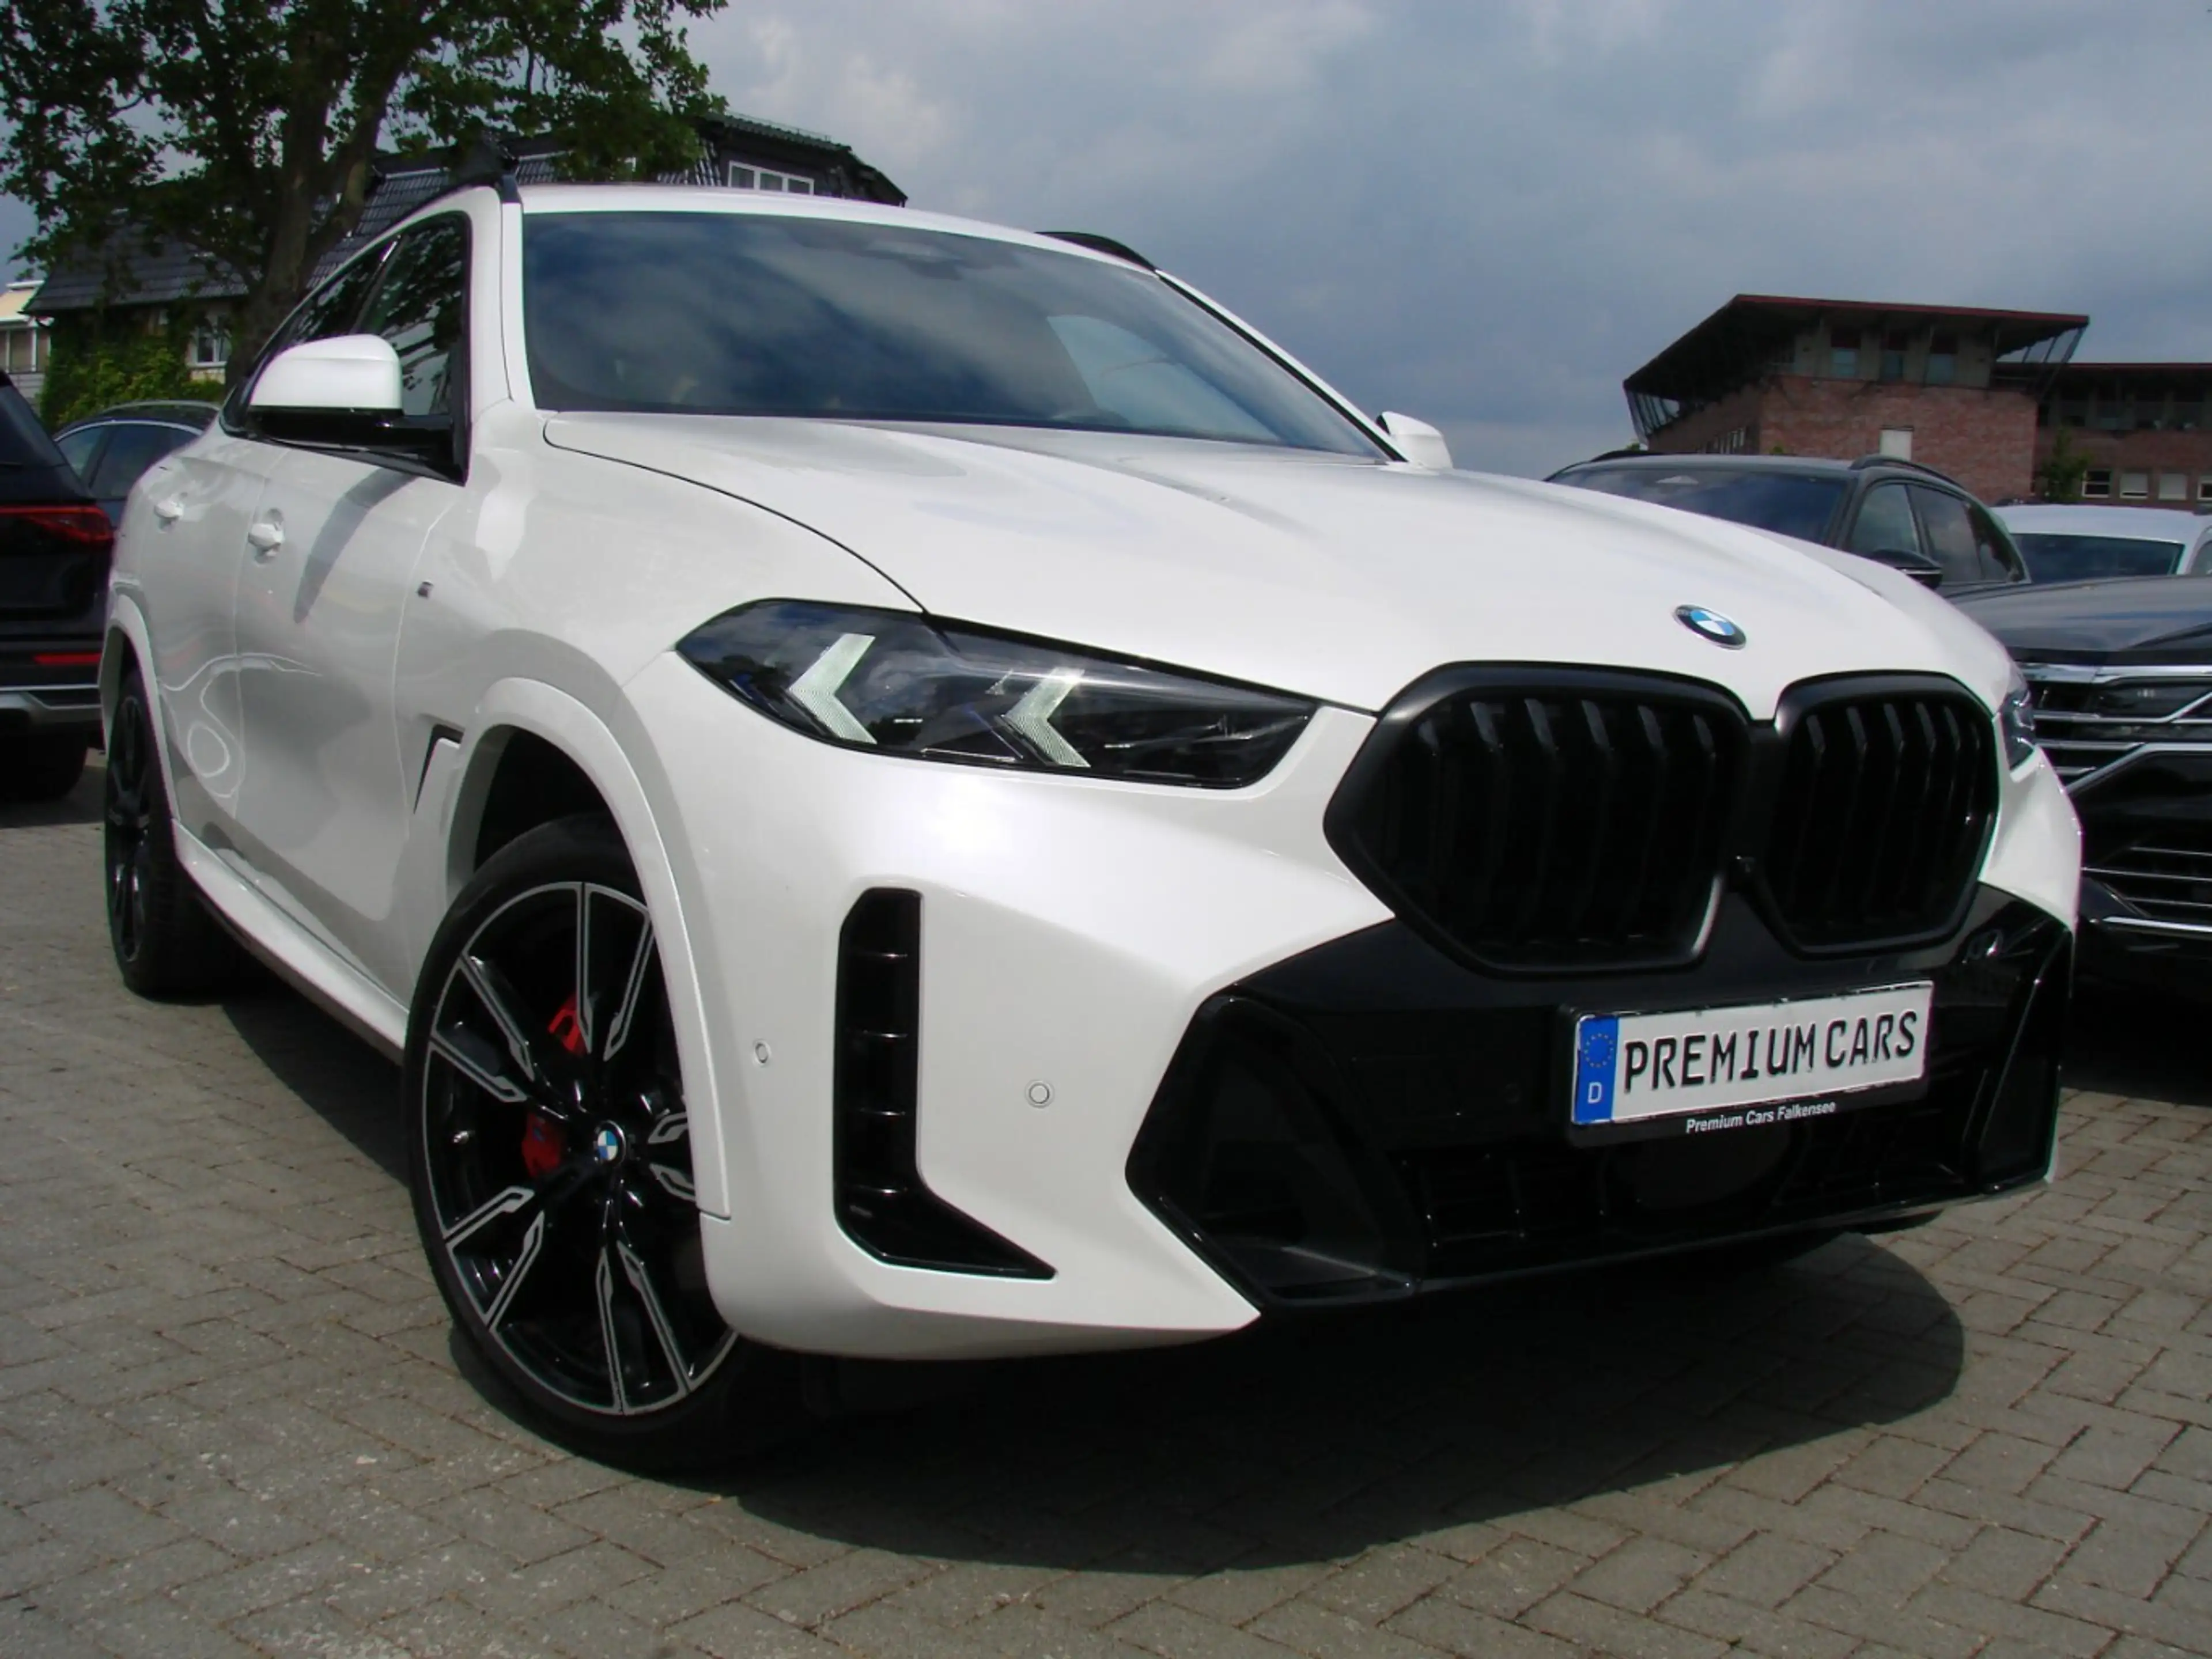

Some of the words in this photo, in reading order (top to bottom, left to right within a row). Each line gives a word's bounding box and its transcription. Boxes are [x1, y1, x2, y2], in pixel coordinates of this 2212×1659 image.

[1624, 1022, 1816, 1093] PREMIUM
[1825, 1010, 1917, 1069] CARS
[1588, 1082, 1602, 1104] D
[1687, 1115, 1742, 1133] Premium
[1746, 1109, 1774, 1125] Cars
[1778, 1101, 1836, 1120] Falkensee
